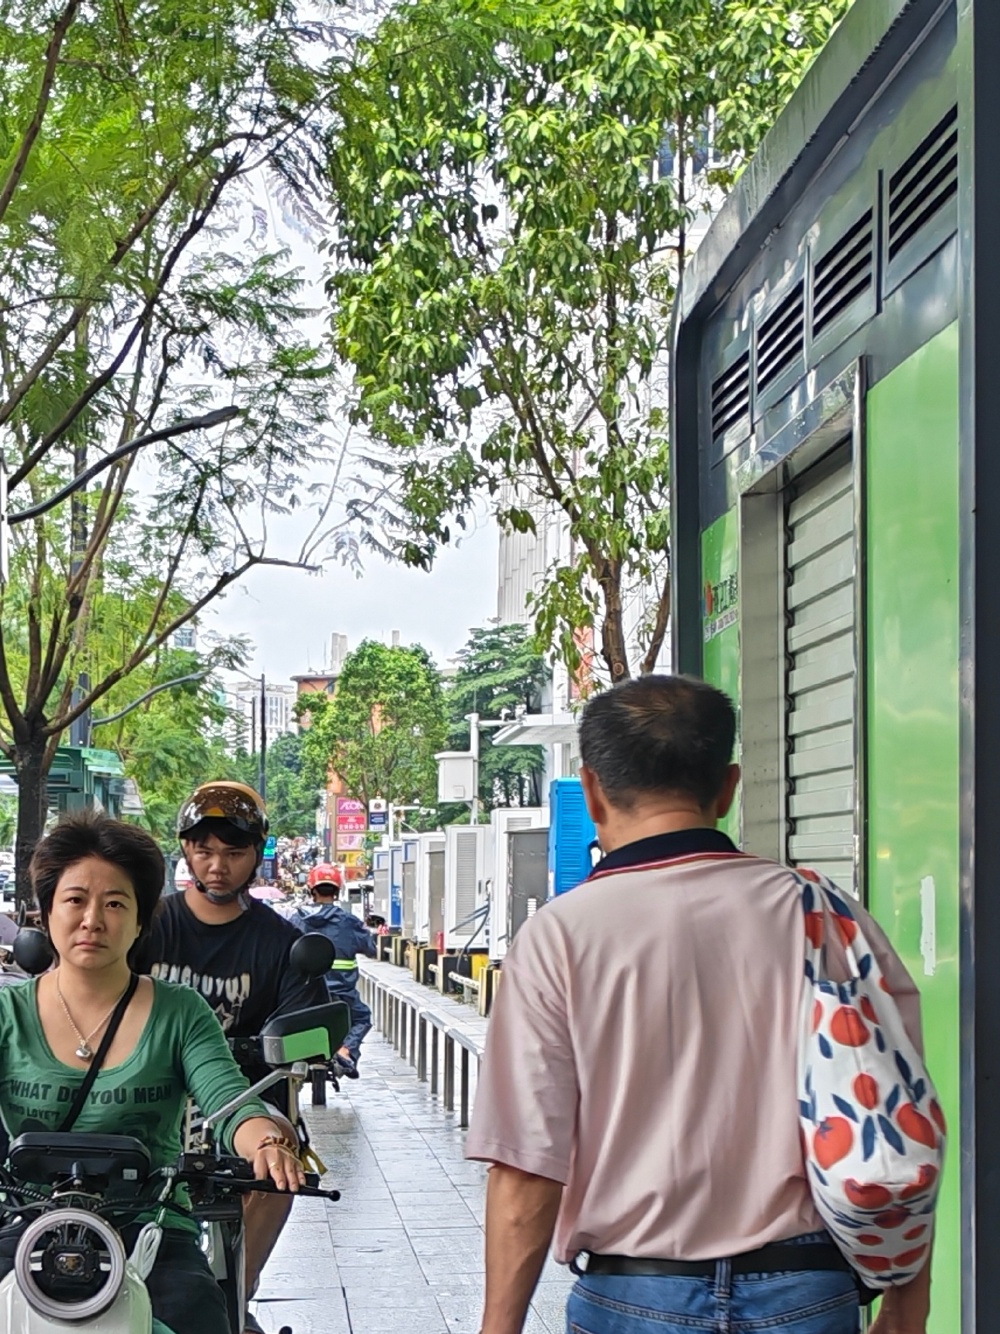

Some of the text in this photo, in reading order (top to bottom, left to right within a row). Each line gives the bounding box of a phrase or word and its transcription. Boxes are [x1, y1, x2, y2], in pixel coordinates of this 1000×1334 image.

[10, 1079, 52, 1100] WHAT
[90, 1087, 127, 1105] YOU
[133, 1084, 172, 1104] MEAN
